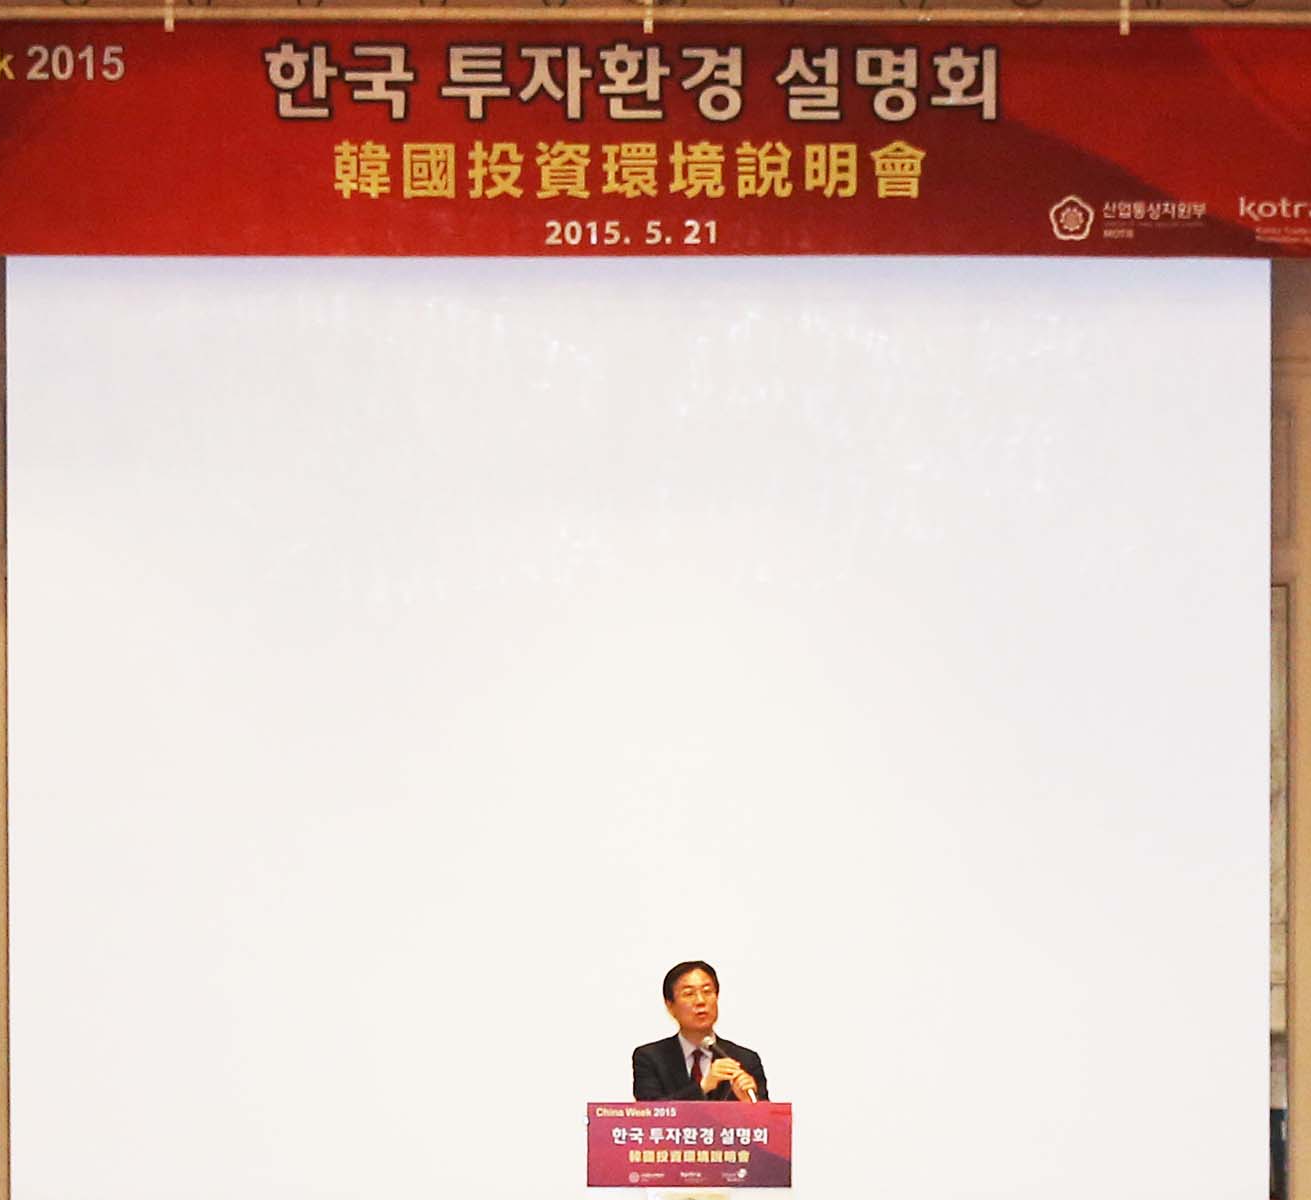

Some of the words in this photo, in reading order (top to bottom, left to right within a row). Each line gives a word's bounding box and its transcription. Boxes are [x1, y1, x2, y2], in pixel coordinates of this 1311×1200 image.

[27, 46, 126, 81] 2015
[264, 41, 415, 119] 한국
[440, 42, 744, 121] 투자환경
[775, 45, 998, 121] 설명회
[333, 139, 927, 200] 韓國投資環境說明會
[545, 219, 630, 245] 2015.
[645, 220, 672, 245] 5.
[683, 219, 719, 245] 21
[596, 1107, 624, 1117] China
[625, 1107, 652, 1117] Week
[653, 1107, 677, 1117] 2015
[612, 1127, 644, 1145] 한국
[650, 1127, 714, 1145] 투자환경
[720, 1127, 769, 1145] 설명회
